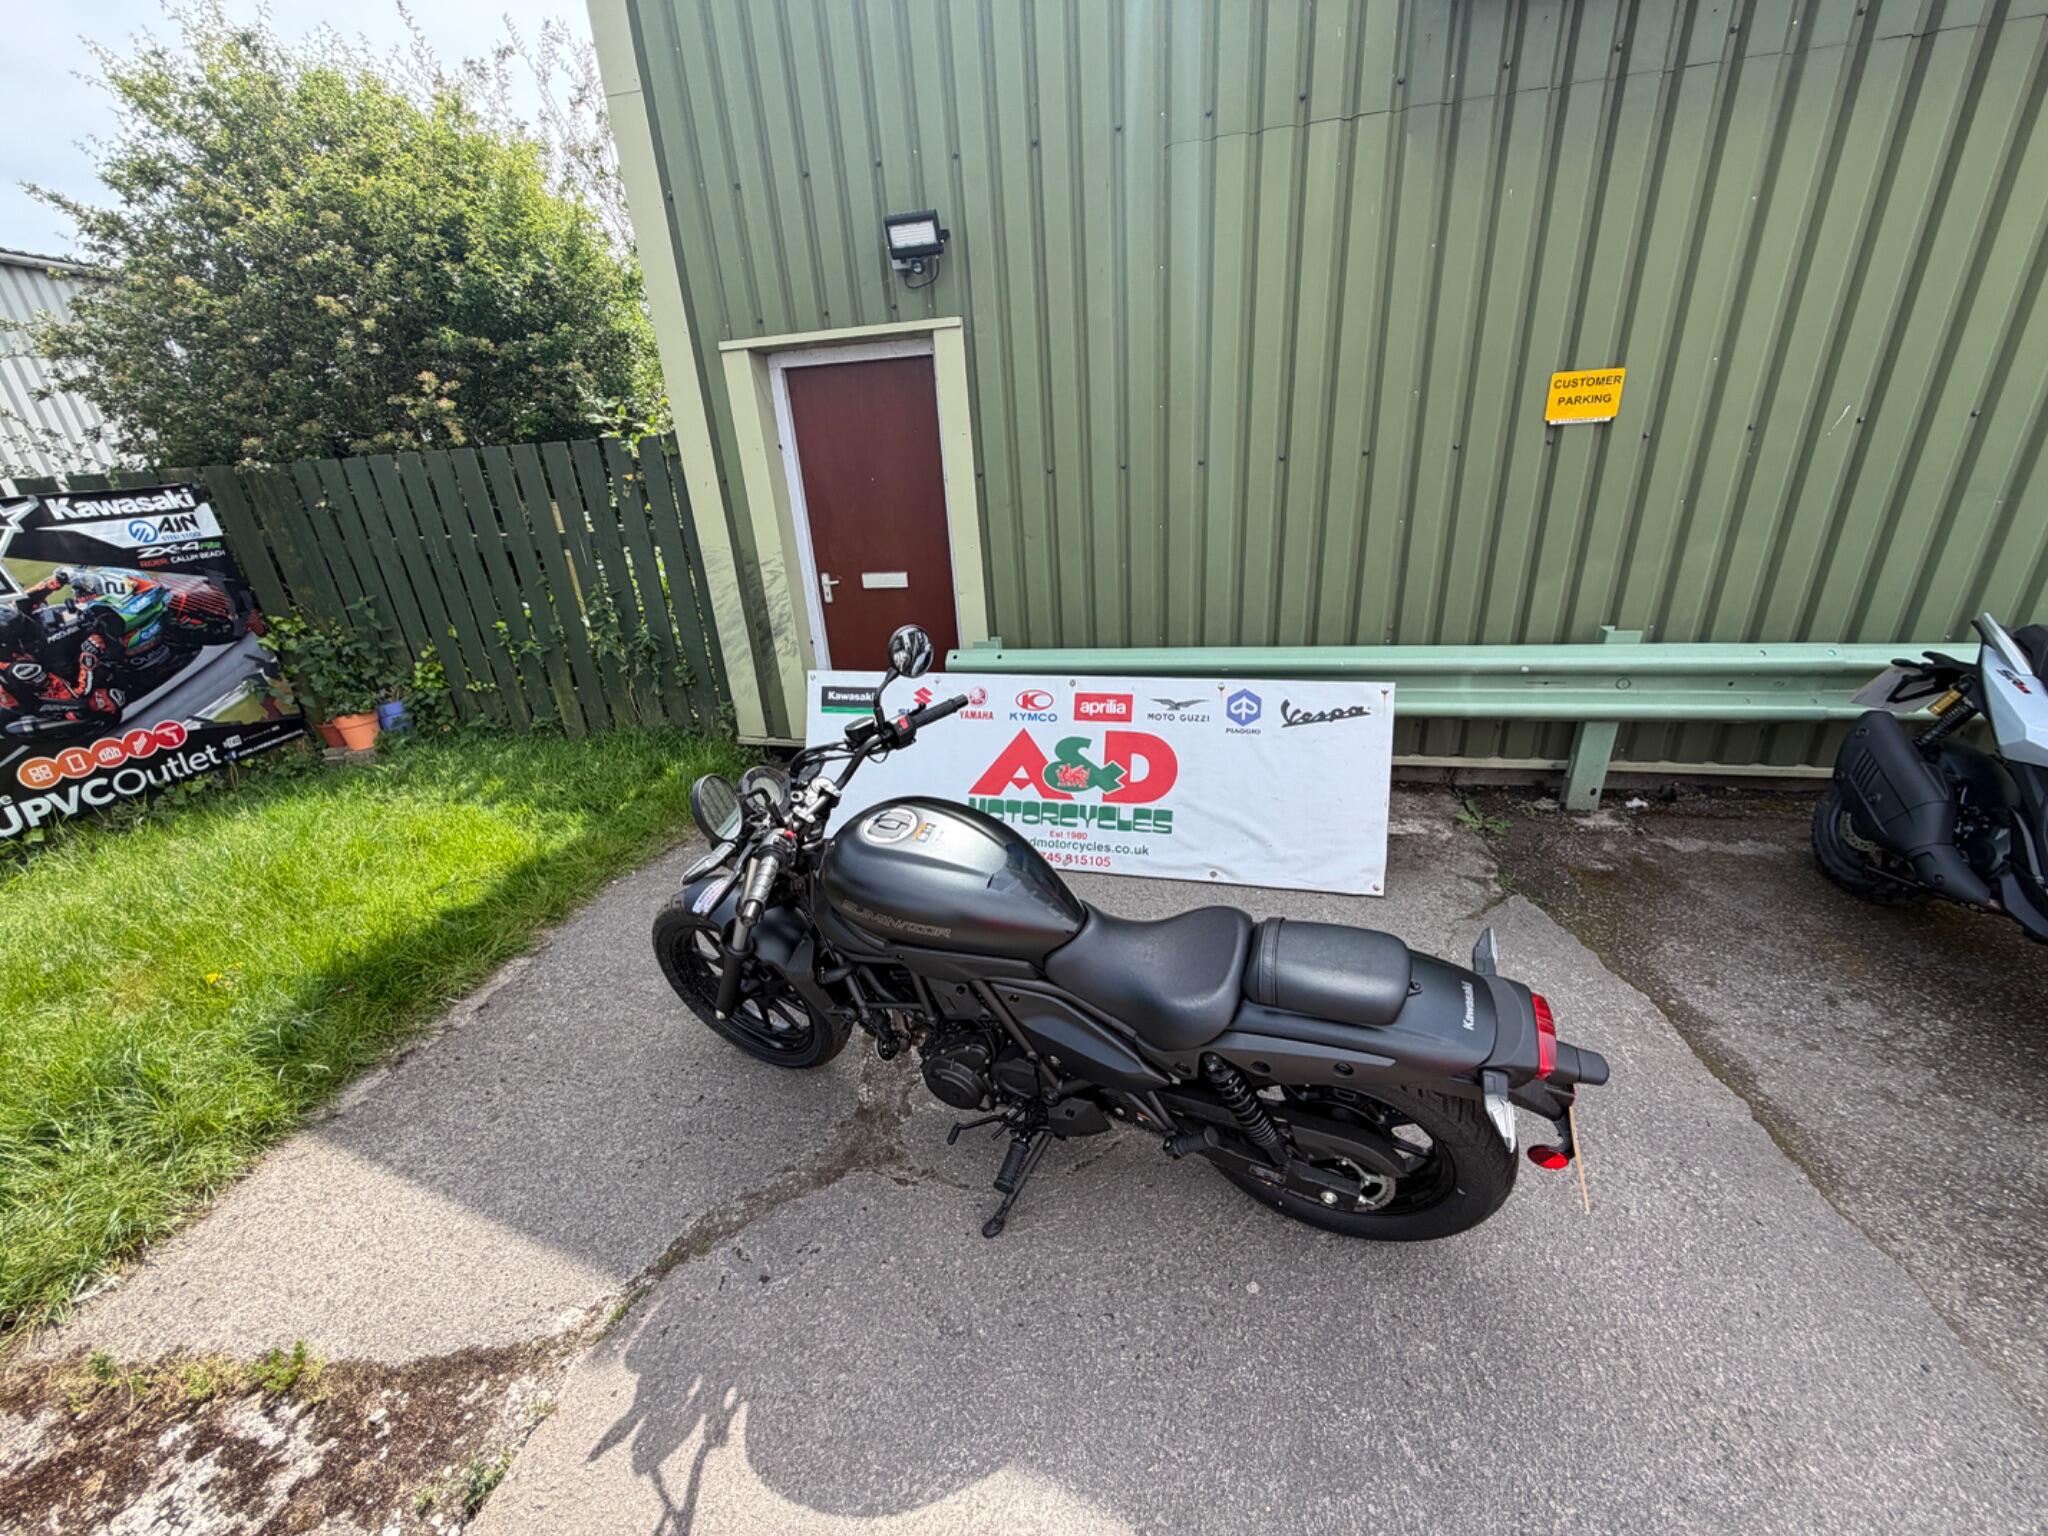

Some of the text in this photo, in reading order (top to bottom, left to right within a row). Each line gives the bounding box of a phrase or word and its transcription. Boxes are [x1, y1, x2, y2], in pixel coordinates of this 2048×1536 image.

[1554, 375, 1622, 389] CUSTOMER
[1557, 393, 1612, 405] PARKING
[45, 488, 196, 520] Kawasaki
[960, 710, 994, 720] YAMAHA
[1080, 699, 1127, 716] aprilia
[1280, 699, 1371, 728] Vespa
[1009, 712, 1058, 722] KYMCO
[1147, 713, 1210, 723] MOTO GUZZI
[968, 728, 1178, 804] A&D
[968, 797, 1174, 834] MOTORCYCLES
[1066, 831, 1088, 840] 1980
[1029, 837, 1149, 855] dmotorcycles.co.uk
[1461, 980, 1475, 1031] Kawasaki
